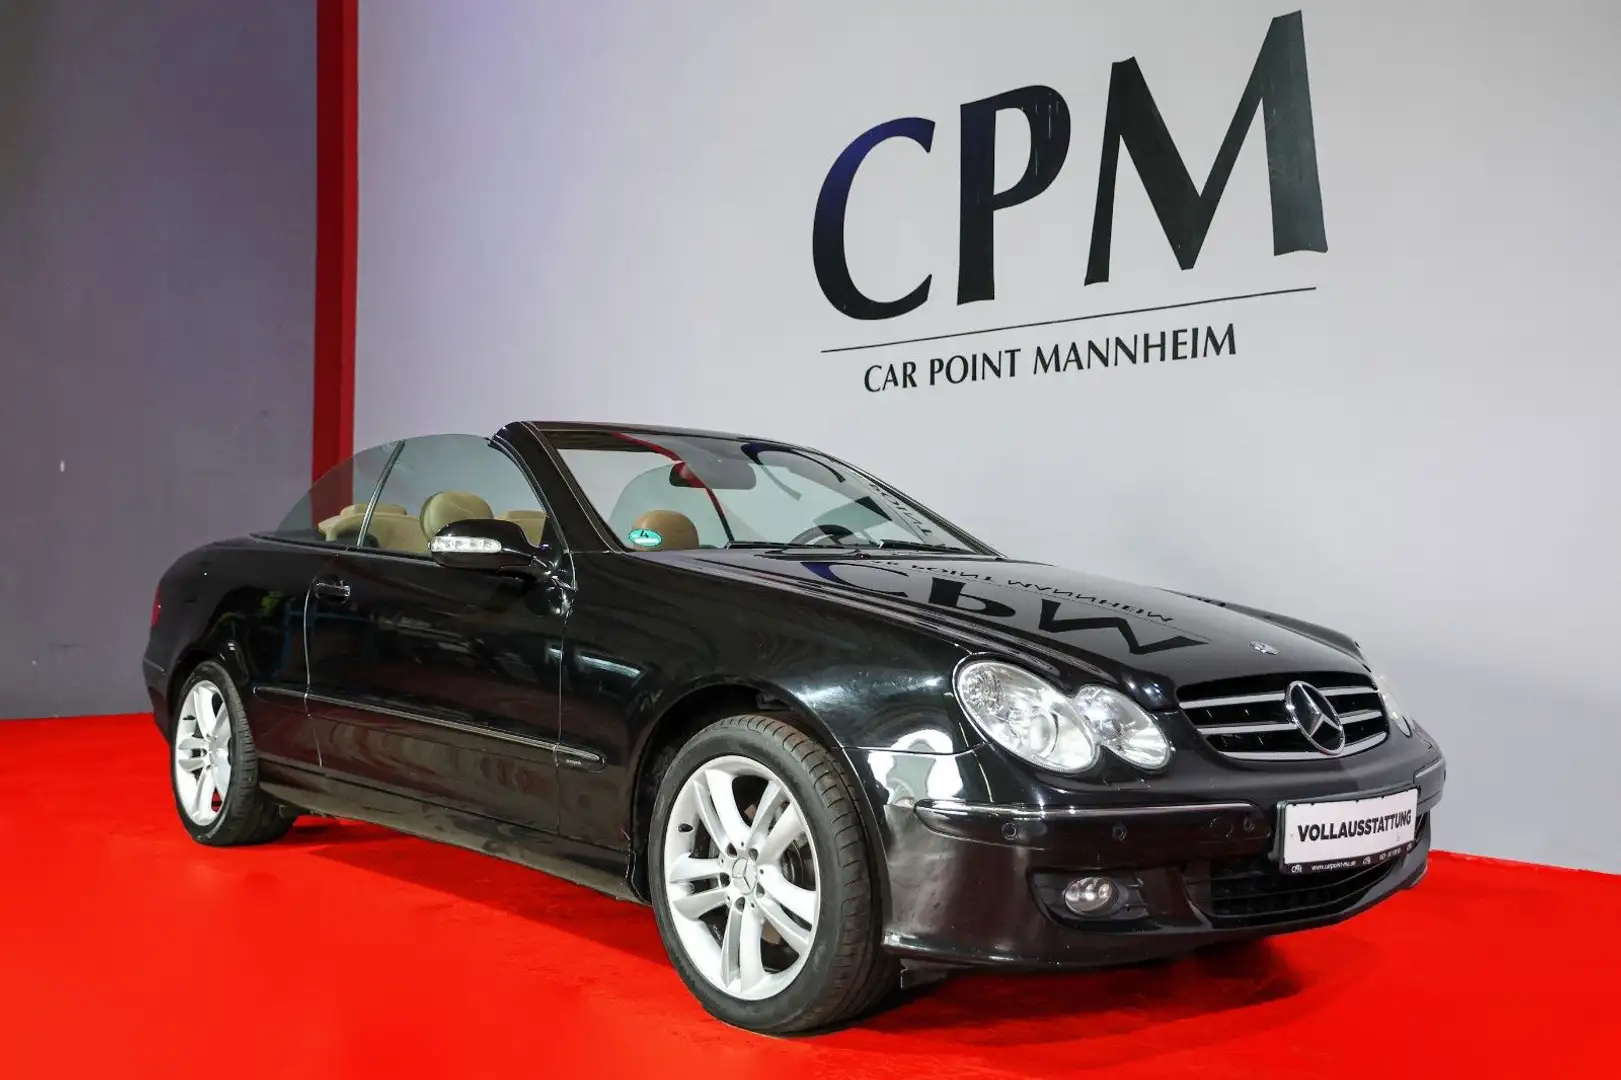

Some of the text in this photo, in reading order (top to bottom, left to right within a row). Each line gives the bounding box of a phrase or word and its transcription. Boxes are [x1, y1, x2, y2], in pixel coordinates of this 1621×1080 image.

[812, 10, 1328, 321] CPM
[864, 323, 1236, 392] CAR POINT MANNHEIM
[1297, 809, 1412, 842] VOLLAUSSTATTUNG
